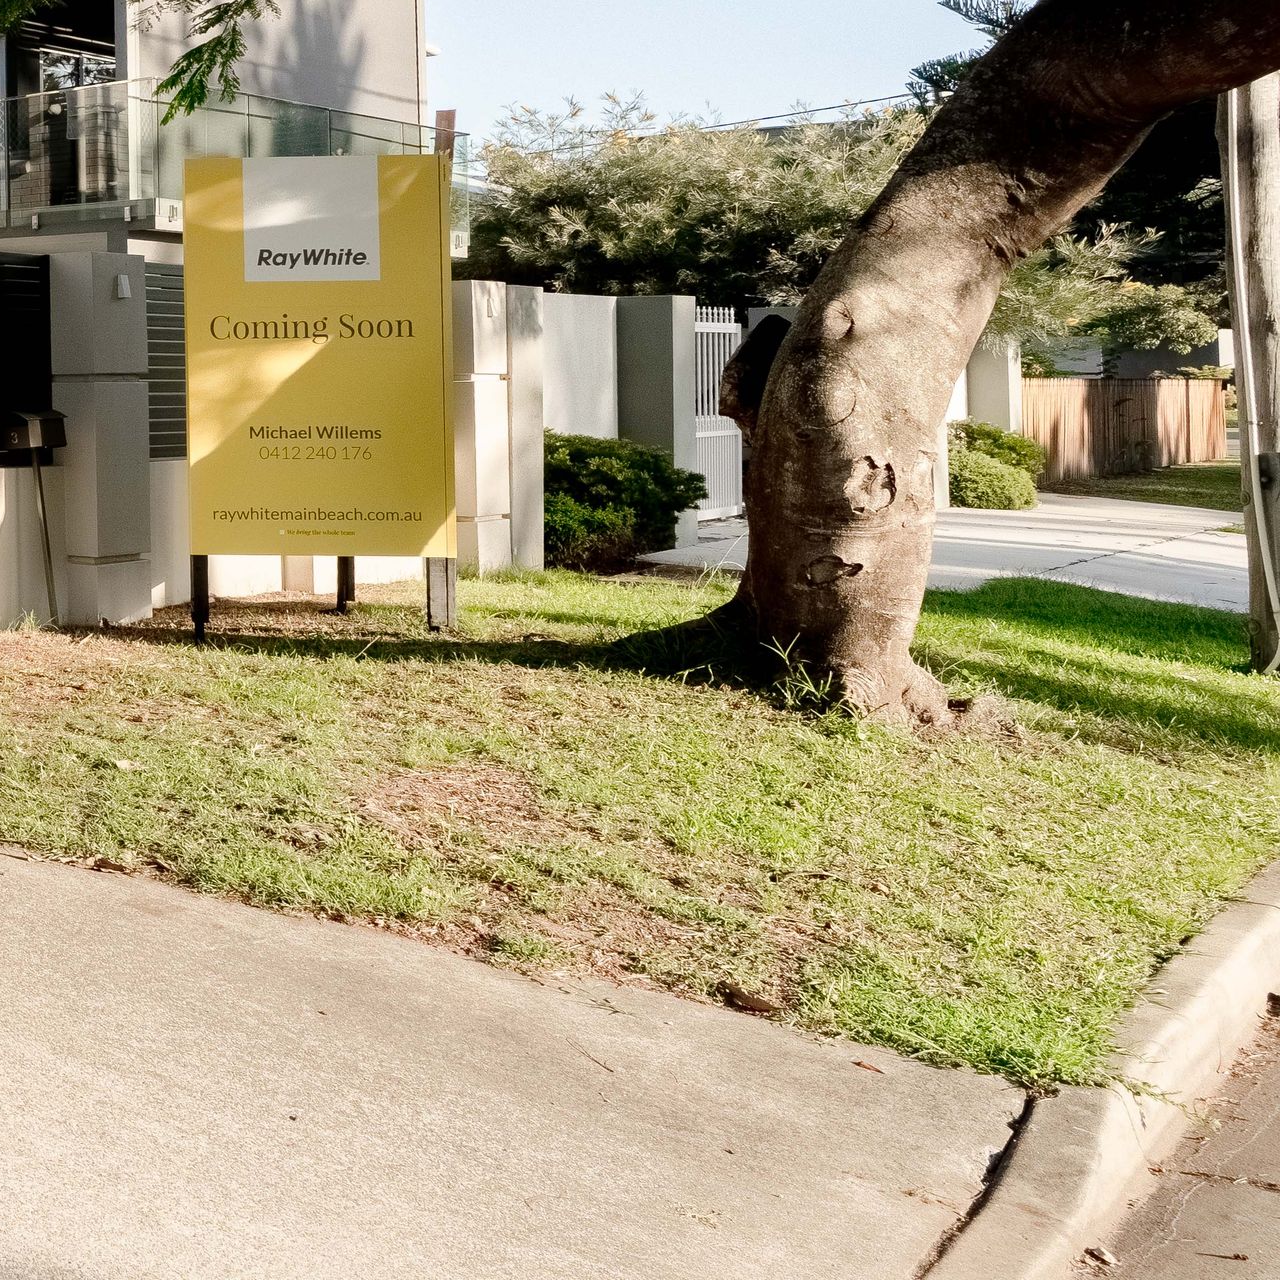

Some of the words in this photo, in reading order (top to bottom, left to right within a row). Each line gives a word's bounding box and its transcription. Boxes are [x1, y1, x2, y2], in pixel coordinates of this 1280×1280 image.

[209, 313, 329, 344] Coming
[338, 313, 415, 339] Soon
[10, 431, 19, 444] 3
[249, 425, 312, 439] Michael
[315, 425, 382, 439] Willems
[259, 446, 301, 460] 0412
[305, 446, 337, 460] 240
[341, 446, 372, 460] 176
[212, 507, 423, 523] raywhitemainbeach.com.au
